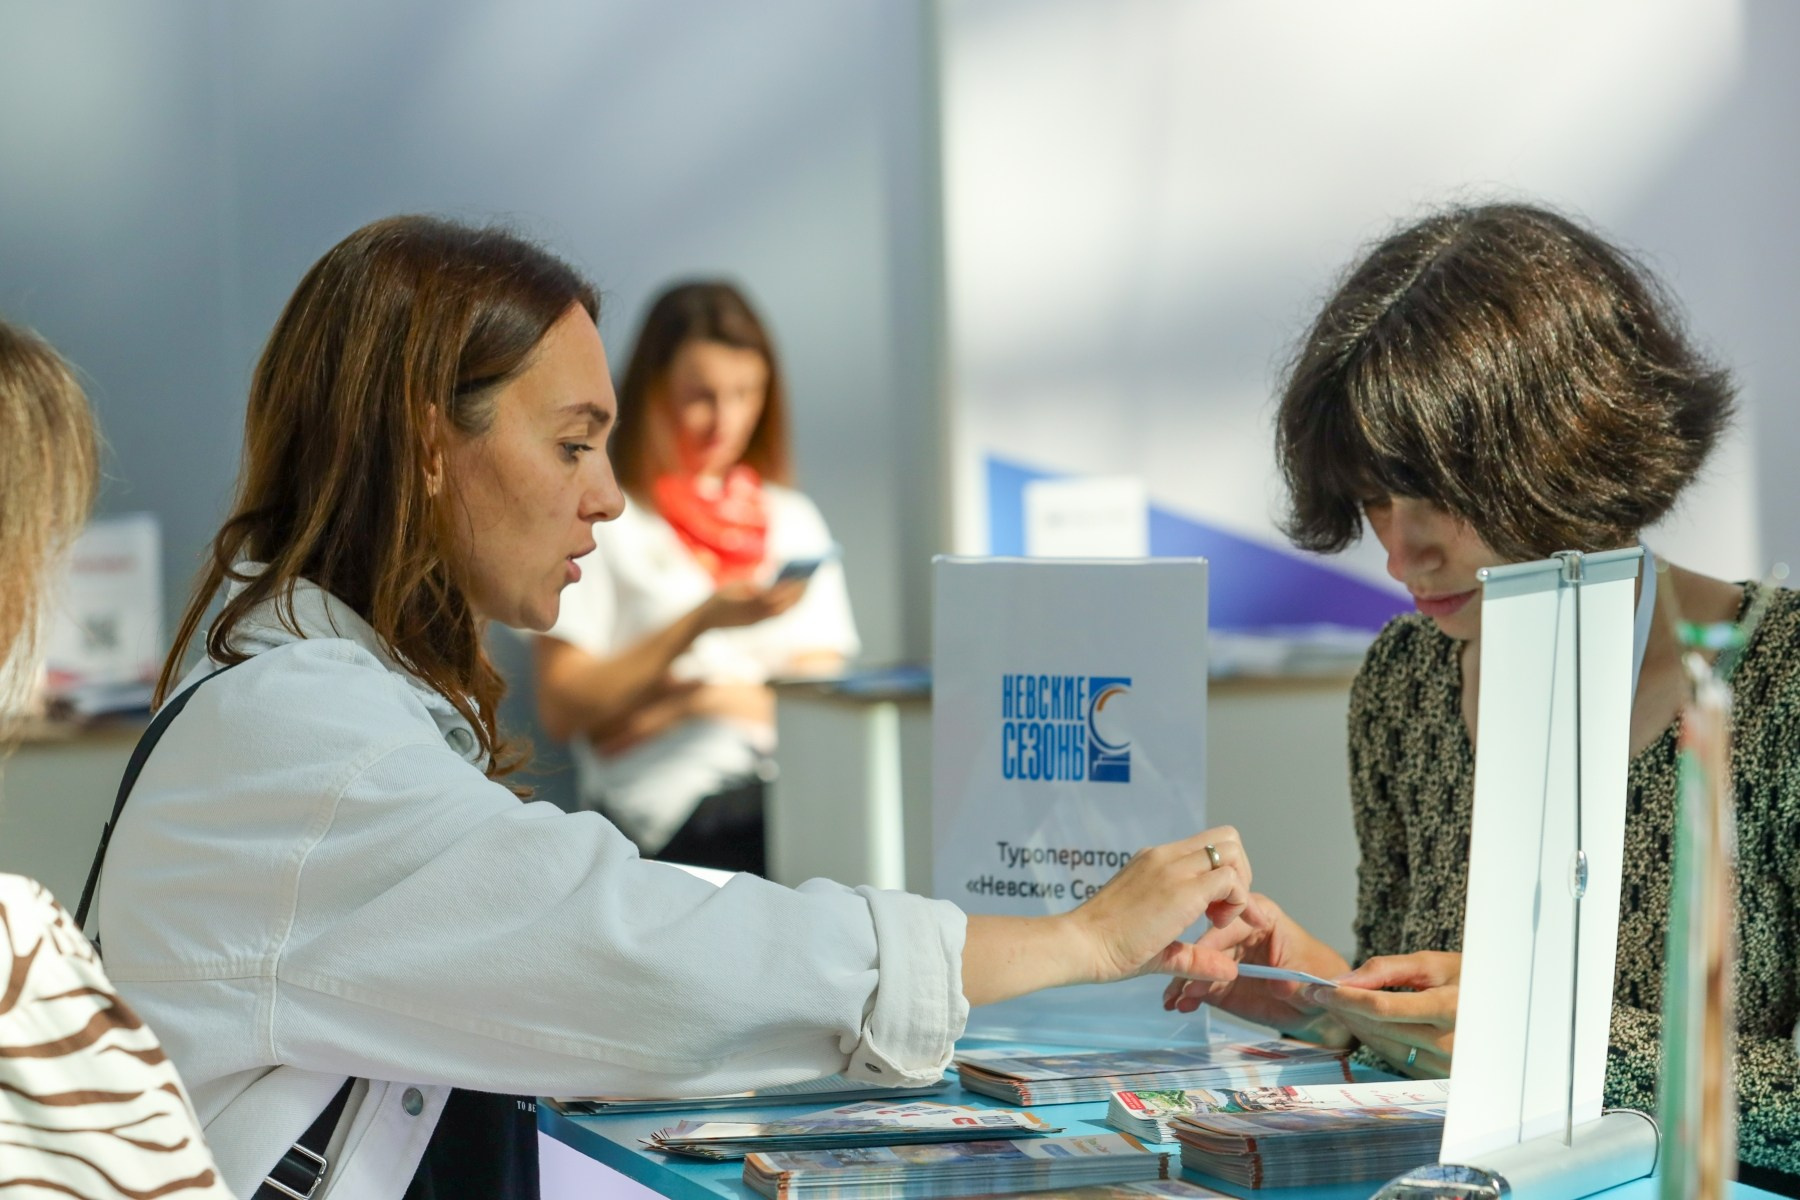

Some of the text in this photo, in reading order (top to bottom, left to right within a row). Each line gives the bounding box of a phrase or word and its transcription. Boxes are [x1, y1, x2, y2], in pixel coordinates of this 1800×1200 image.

[1002, 674, 1085, 720] НЕВСКИЕ
[997, 841, 1132, 870] Туроператор
[966, 874, 1066, 899] «Невские
[516, 1100, 526, 1110] TO
